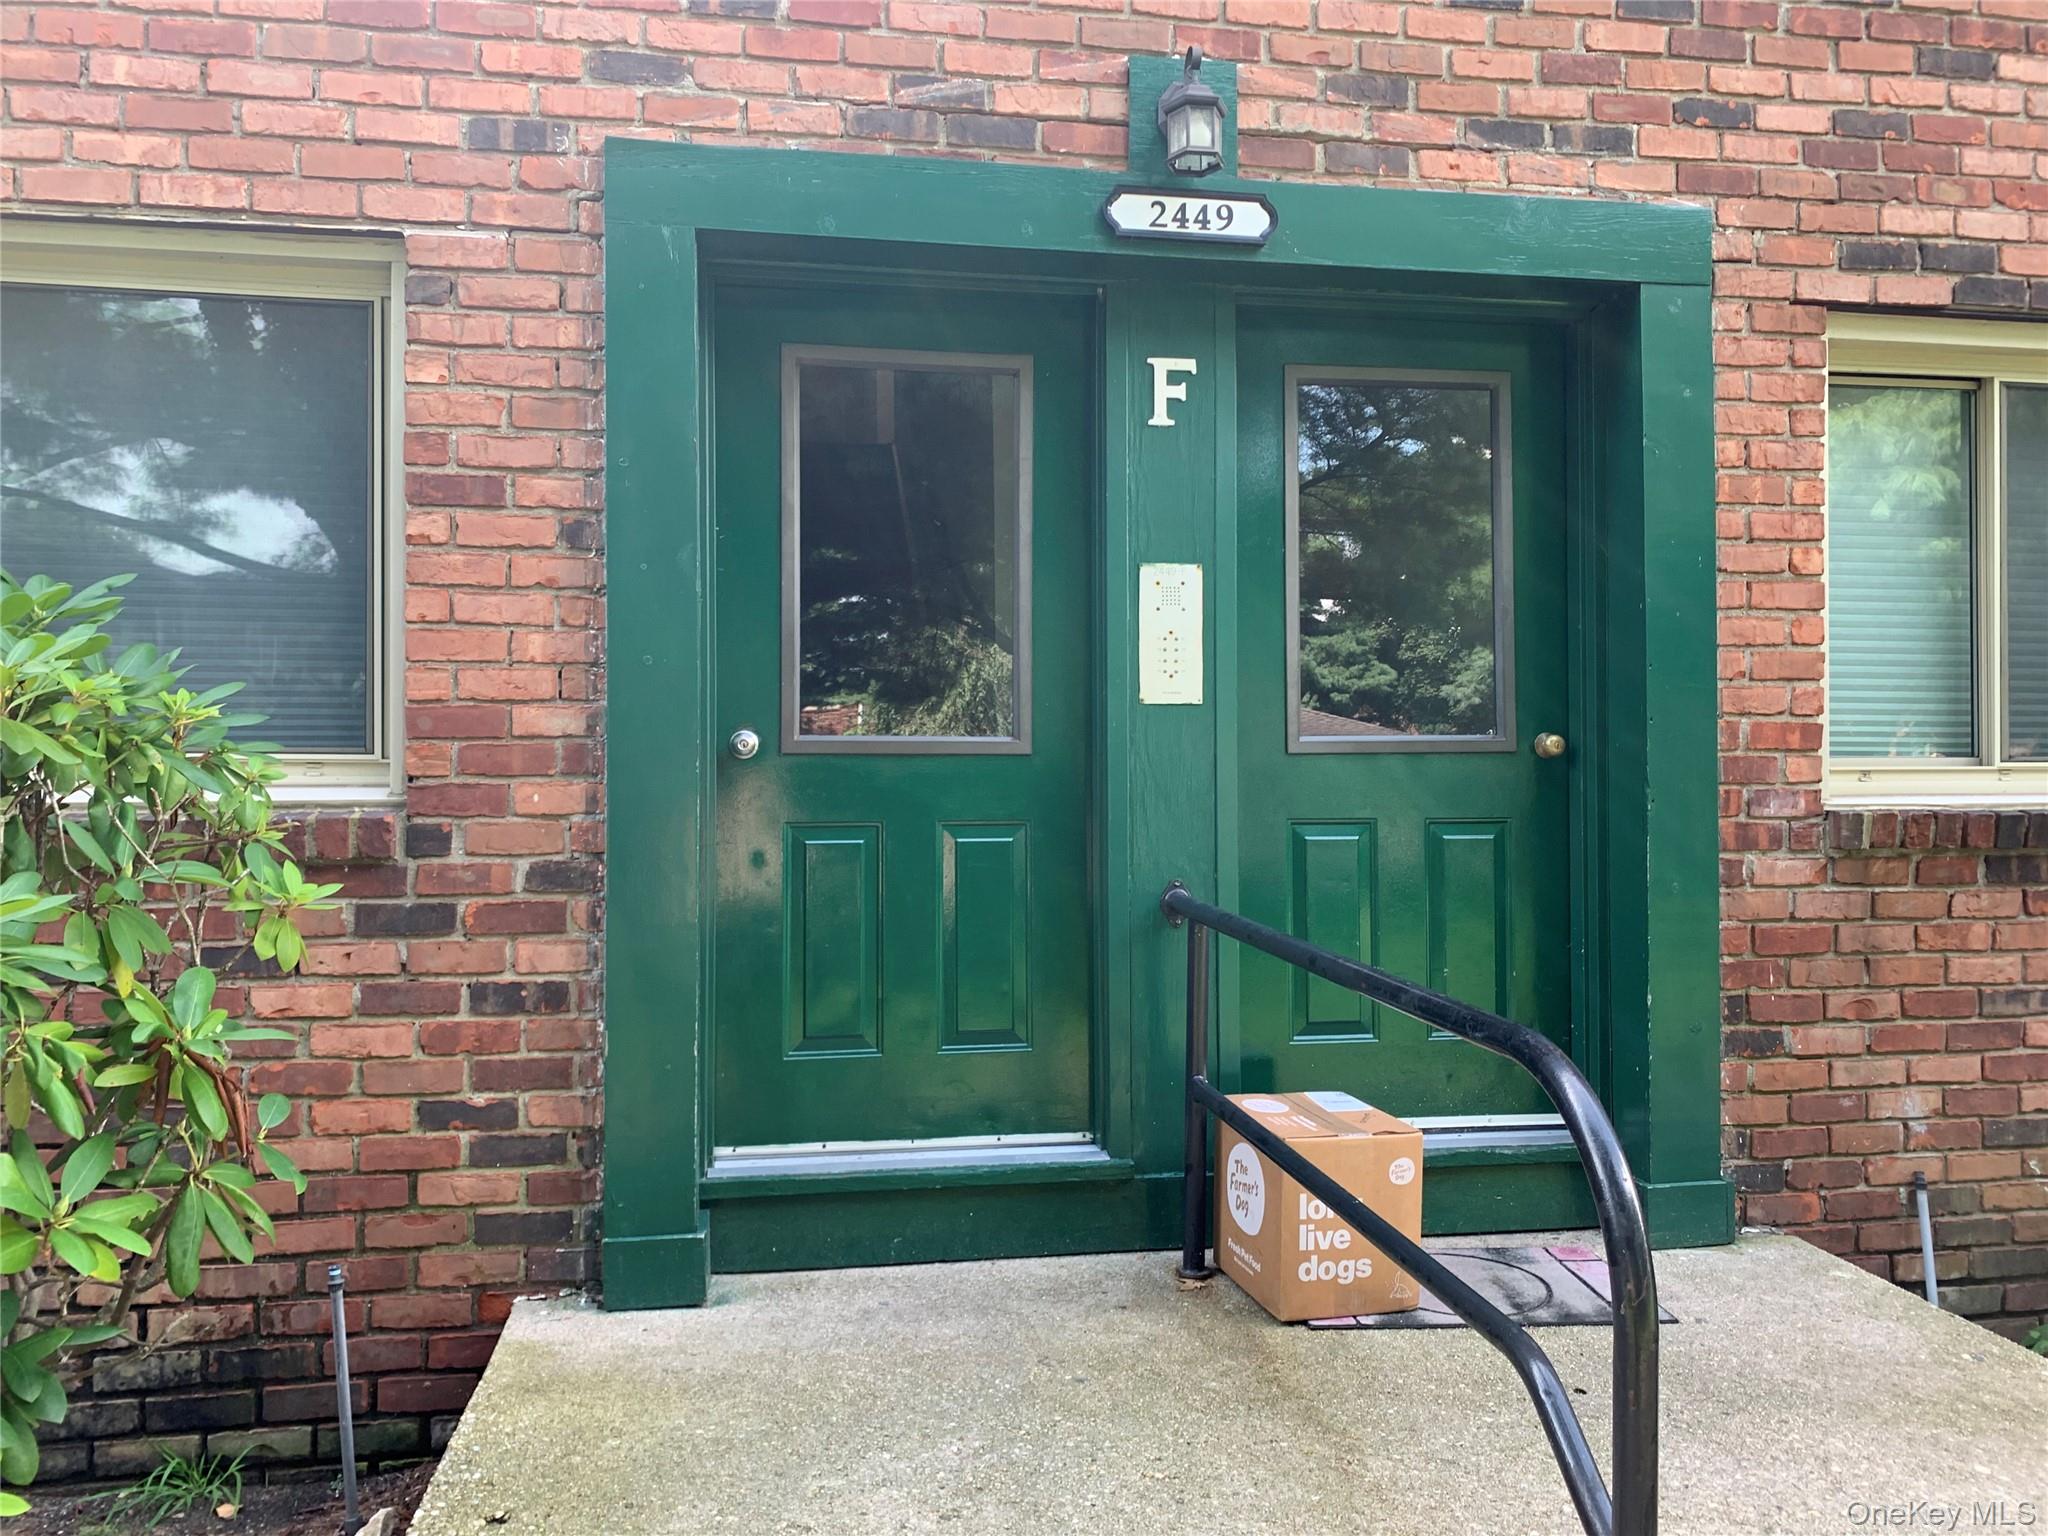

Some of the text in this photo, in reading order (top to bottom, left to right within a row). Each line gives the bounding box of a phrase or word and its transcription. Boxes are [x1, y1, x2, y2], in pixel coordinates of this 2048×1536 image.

[1149, 200, 1234, 231] 2449
[1146, 357, 1198, 426] F
[1234, 1159, 1249, 1176] The
[1230, 1172, 1260, 1198] Farmer's
[1235, 1194, 1249, 1219] Dog
[1299, 1224, 1352, 1251] live
[1298, 1254, 1373, 1285] dogs
